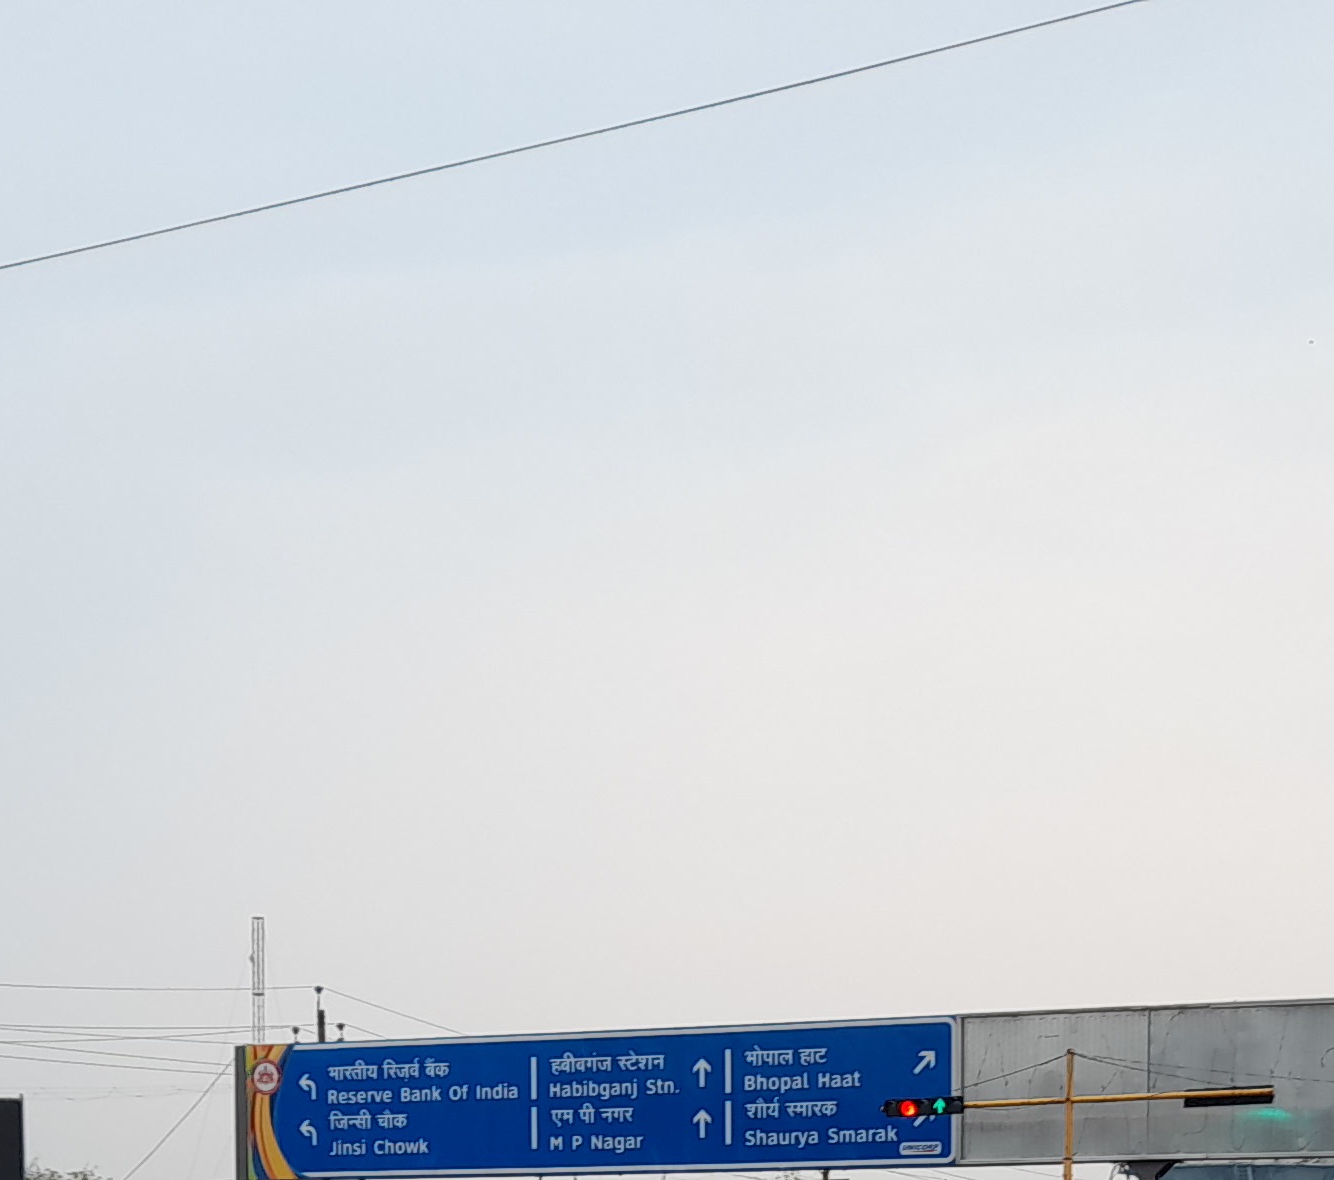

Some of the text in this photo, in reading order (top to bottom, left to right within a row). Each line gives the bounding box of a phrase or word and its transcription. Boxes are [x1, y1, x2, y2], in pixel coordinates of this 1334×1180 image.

[549, 1050, 665, 1075] हबीबगंज स्टेशन
[744, 1044, 828, 1067] भोपाल हाट
[327, 1060, 378, 1081] भारतीय
[743, 1070, 862, 1093] Bhopal Haat
[327, 1082, 519, 1104] Reserve Bank Of India
[549, 1078, 680, 1100] Habibganj Stn.
[550, 1102, 634, 1128] एम पी नगर
[744, 1096, 838, 1119] शौर्य स्मारक
[328, 1109, 408, 1130] जिन्सी चौक
[329, 1138, 429, 1156] Jinsi Chowk
[550, 1134, 644, 1153] M P Nagar
[744, 1124, 898, 1149] Shaurya Smarak
